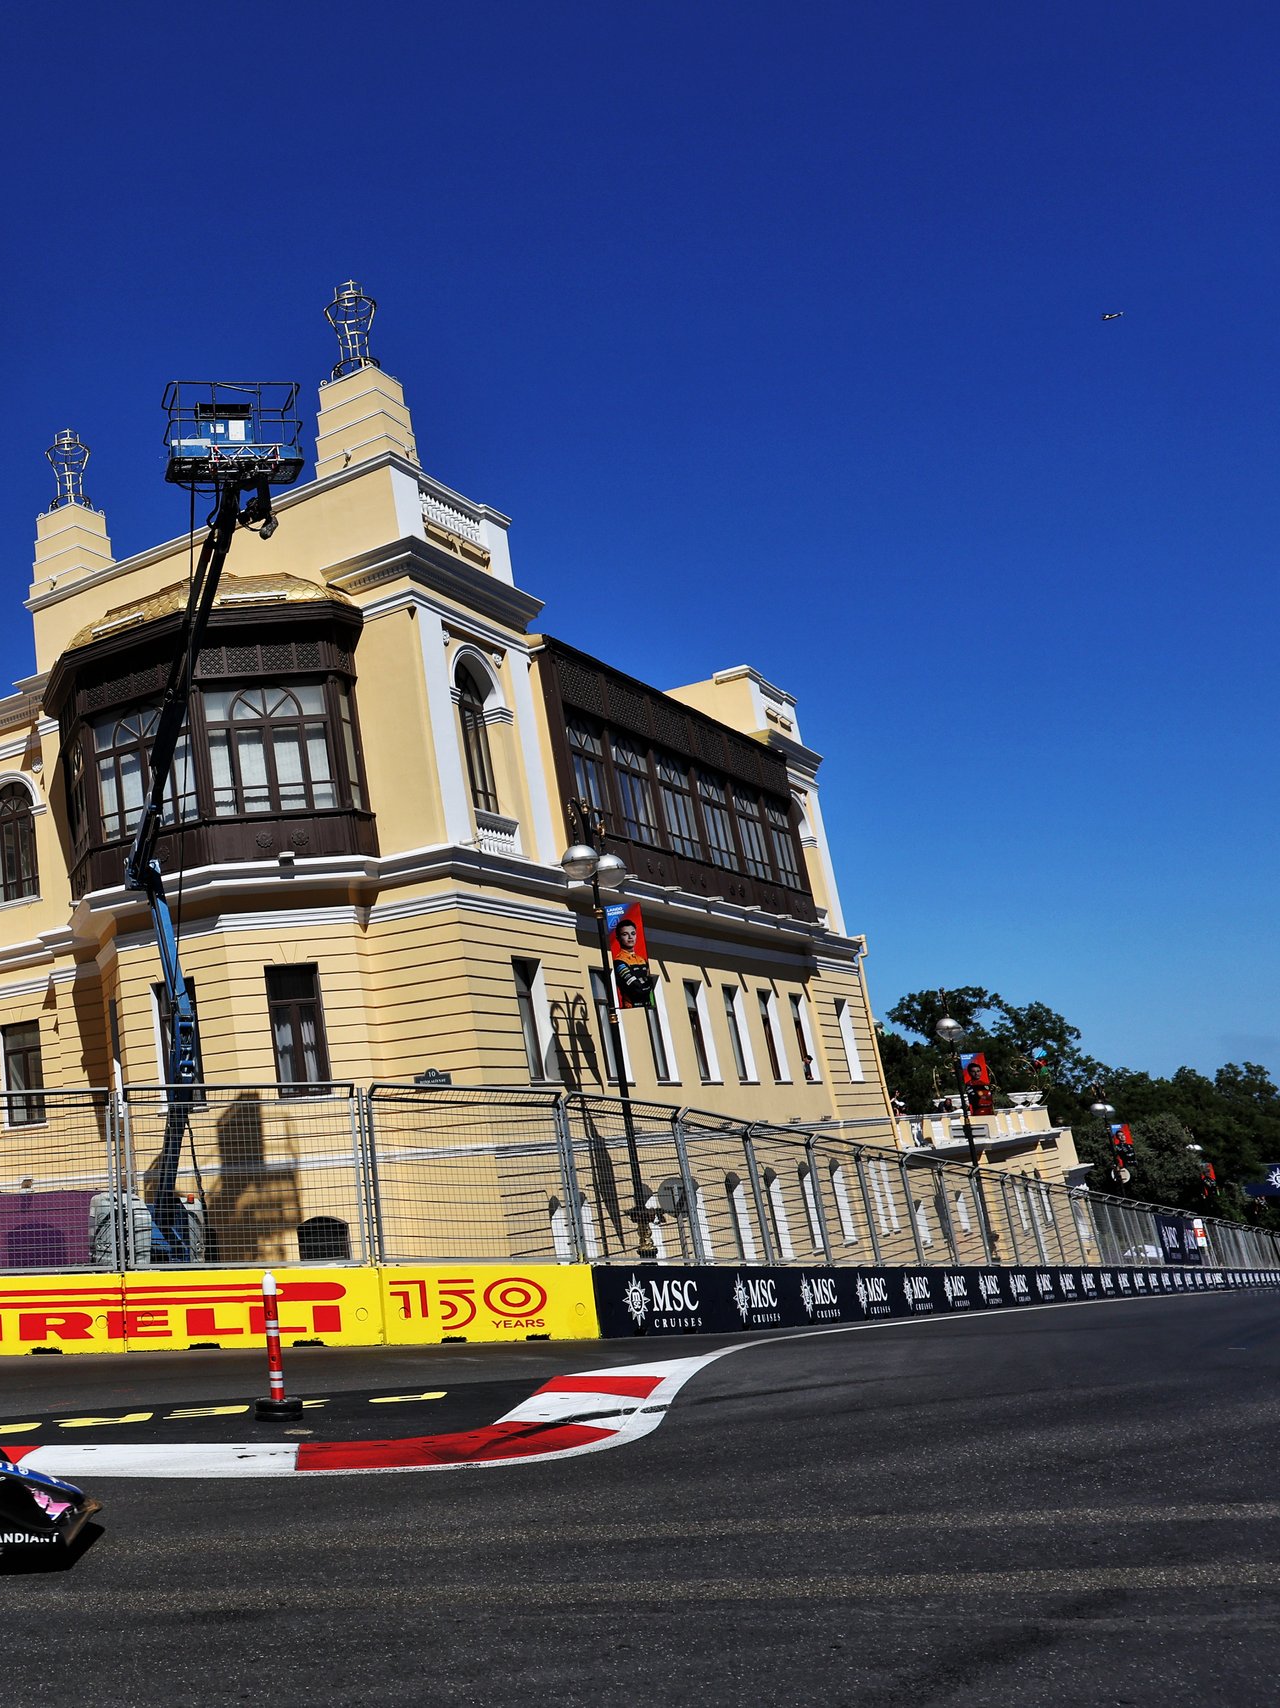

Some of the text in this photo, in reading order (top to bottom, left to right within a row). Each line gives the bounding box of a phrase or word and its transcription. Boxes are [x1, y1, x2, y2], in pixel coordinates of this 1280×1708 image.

[428, 1070, 436, 1078] 10
[649, 1280, 699, 1312] MSC
[748, 1279, 778, 1308] MSC
[811, 1278, 837, 1304] MSC
[865, 1277, 888, 1302] MSC
[910, 1276, 930, 1299] MSC
[389, 1277, 547, 1330] 150
[816, 1309, 841, 1319] CRUISES
[492, 1319, 545, 1329] YEARS
[654, 1317, 702, 1328] CRUISES
[752, 1313, 781, 1324] CRUISES
